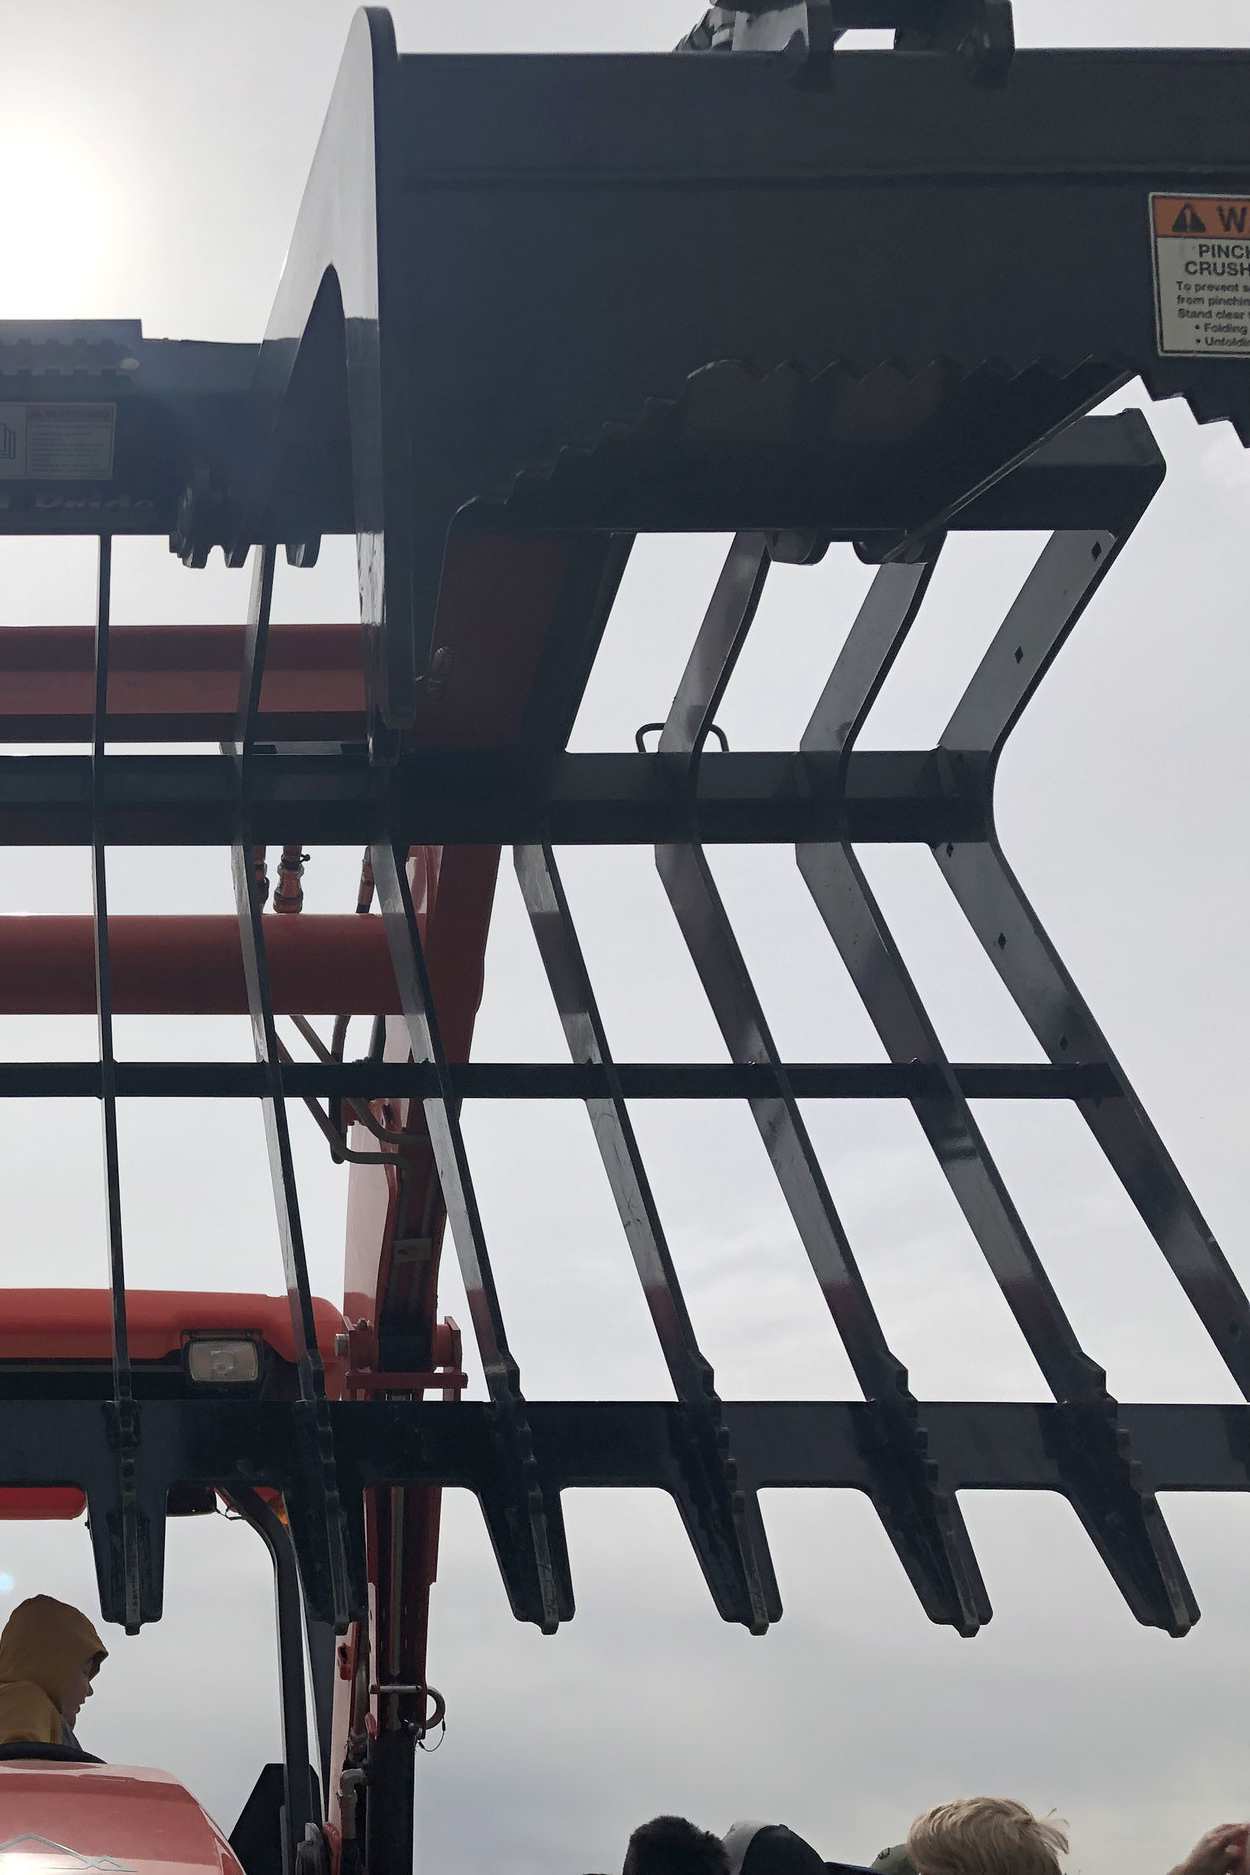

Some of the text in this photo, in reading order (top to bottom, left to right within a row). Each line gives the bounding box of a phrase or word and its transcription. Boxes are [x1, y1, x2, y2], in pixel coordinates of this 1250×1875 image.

[1176, 281, 1191, 292] To
[1195, 282, 1239, 293] prevent
[1176, 294, 1205, 305] from
[1177, 308, 1245, 319] Stand clear
[1204, 323, 1248, 335] Folding
